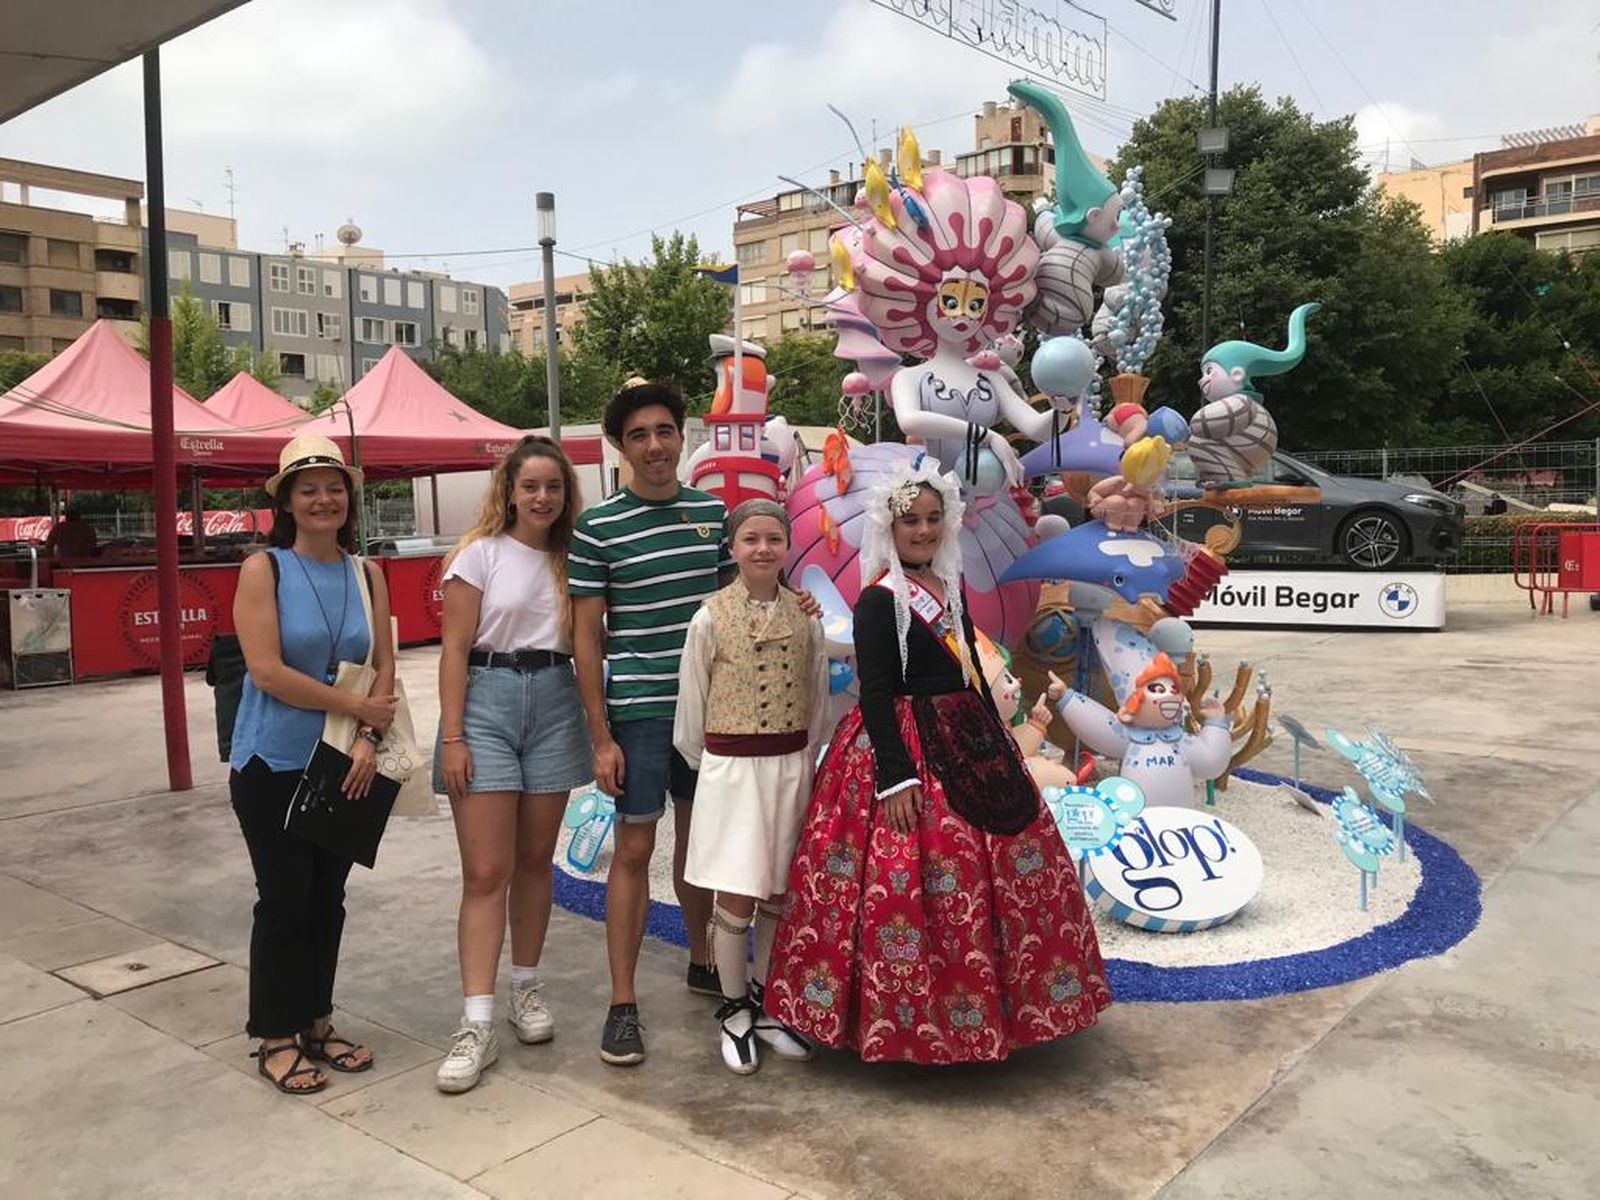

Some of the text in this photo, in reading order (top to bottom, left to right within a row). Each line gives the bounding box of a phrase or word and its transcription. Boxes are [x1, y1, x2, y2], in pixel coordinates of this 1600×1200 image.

[1275, 586, 1360, 613] Begar
[134, 608, 207, 626] ESTLLA
[1146, 756, 1175, 767] MAR
[1112, 816, 1237, 912] glop!
